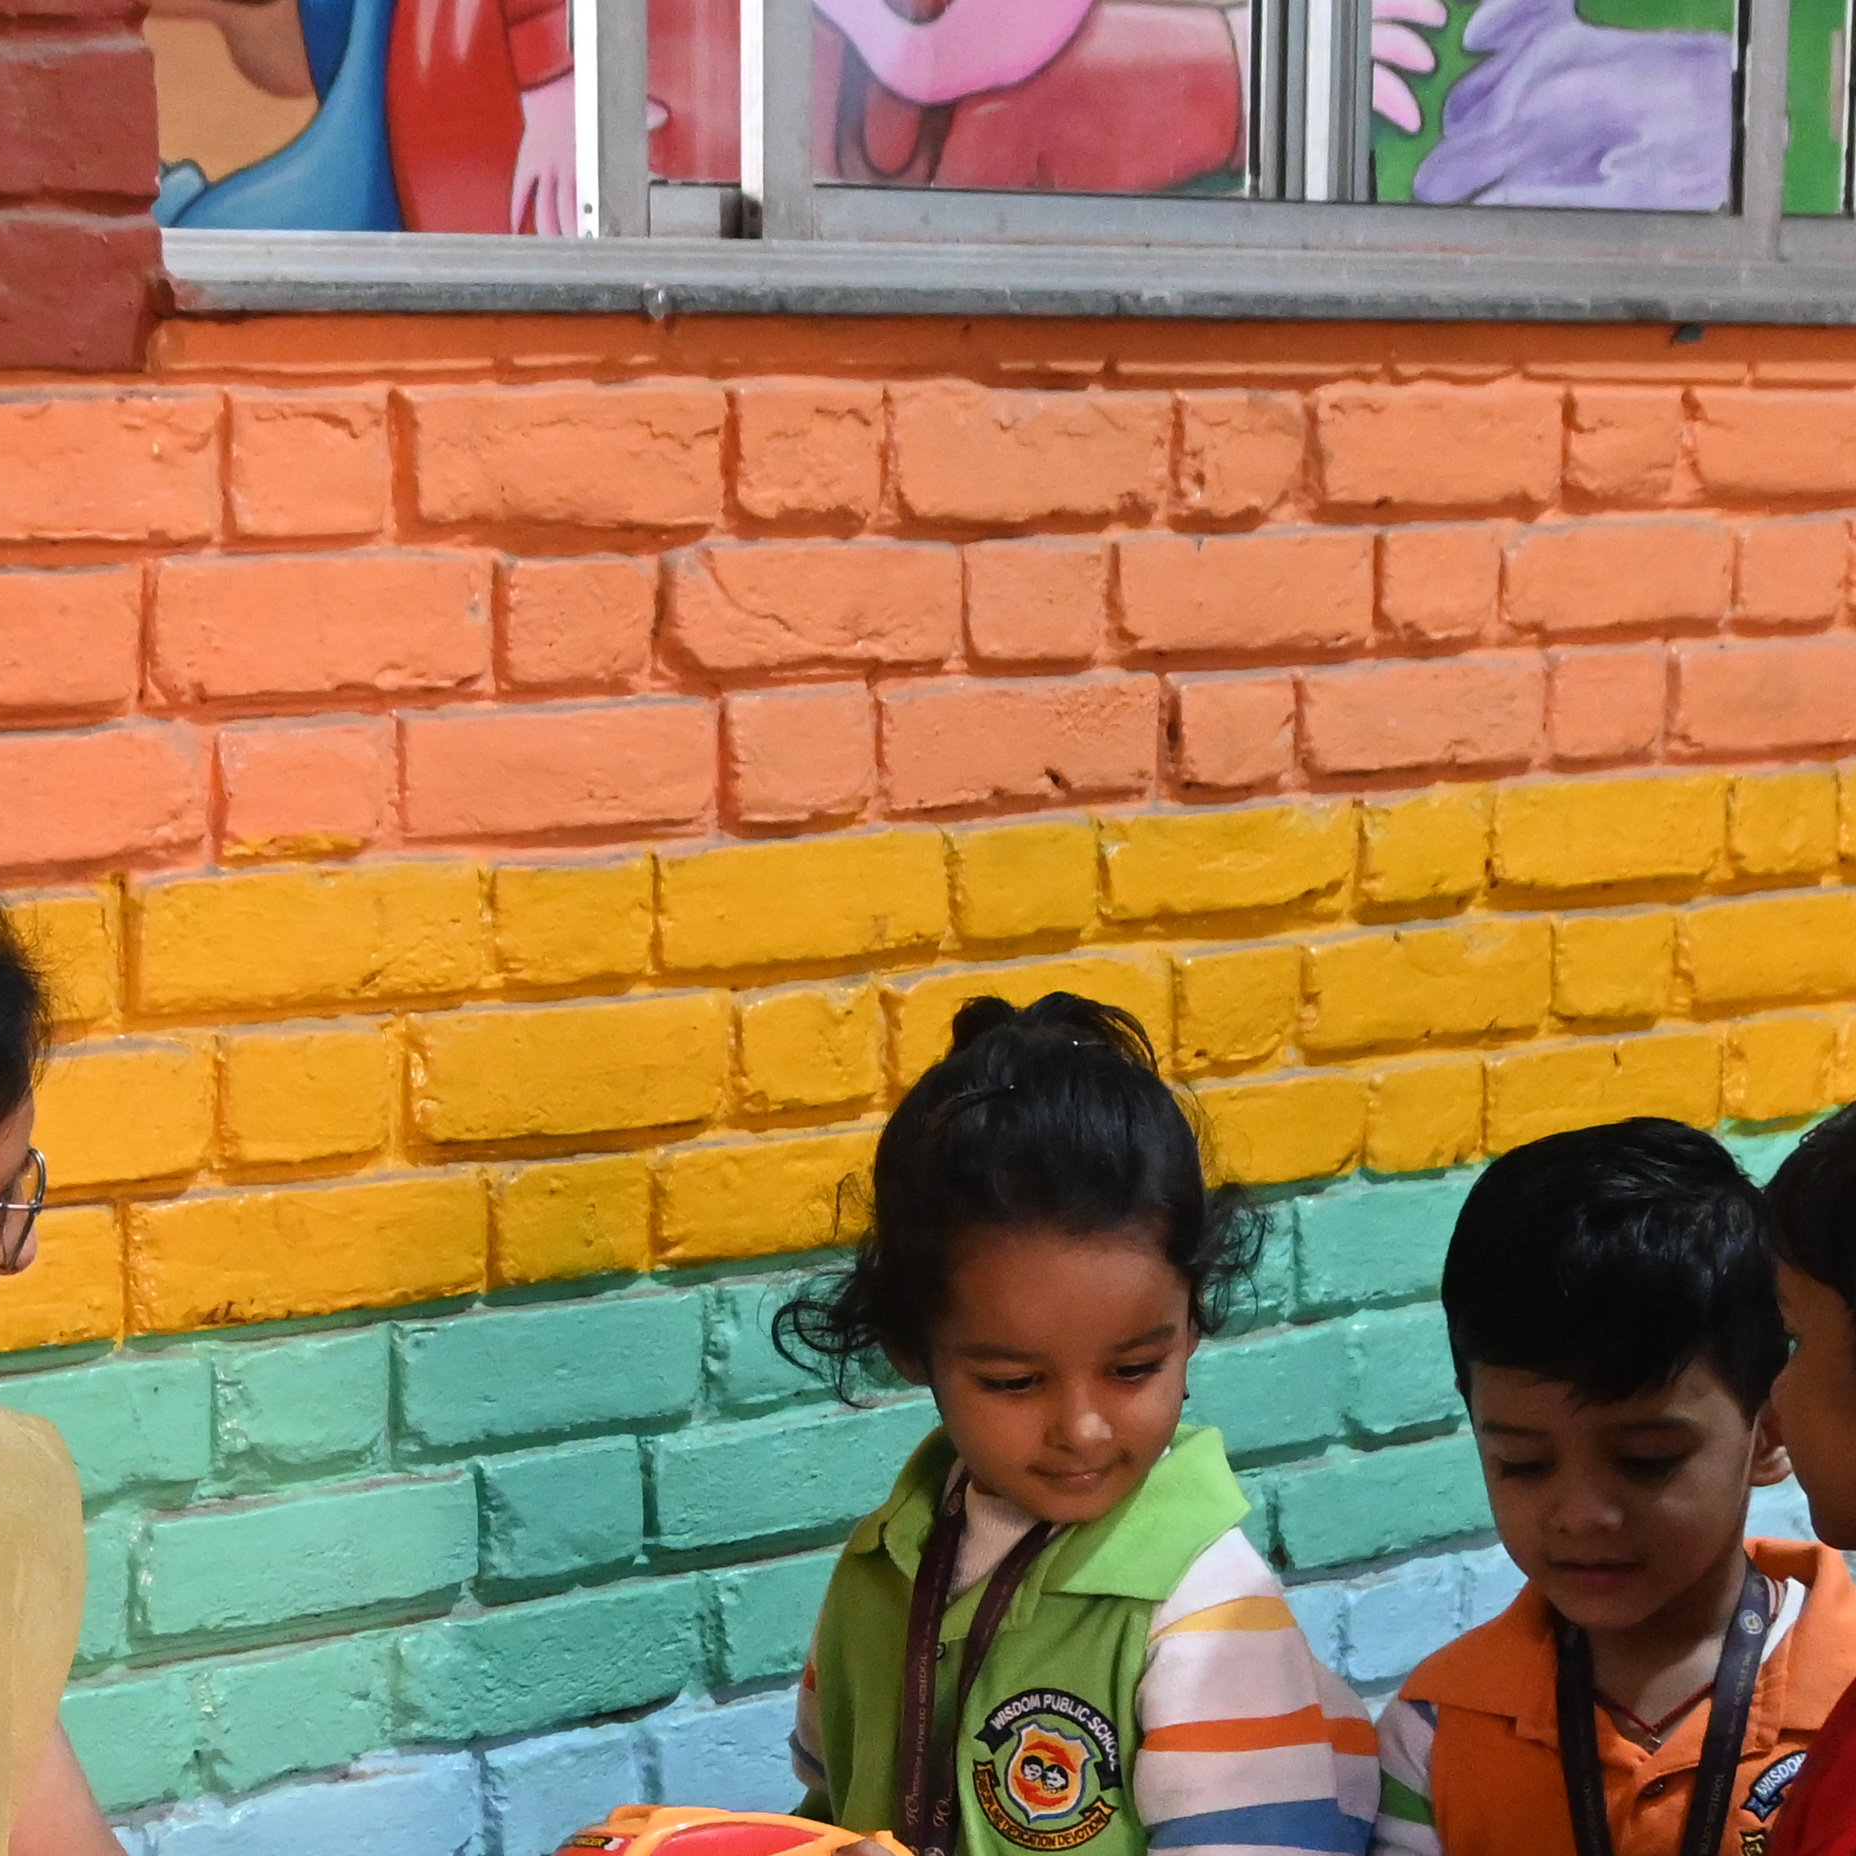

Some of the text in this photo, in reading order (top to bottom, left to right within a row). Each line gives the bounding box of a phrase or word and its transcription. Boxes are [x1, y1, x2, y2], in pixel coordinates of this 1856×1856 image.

[991, 1694, 1119, 1772] WISDOM PUBLIC SCHOOL
[1057, 1812, 1107, 1845] DEVOTION
